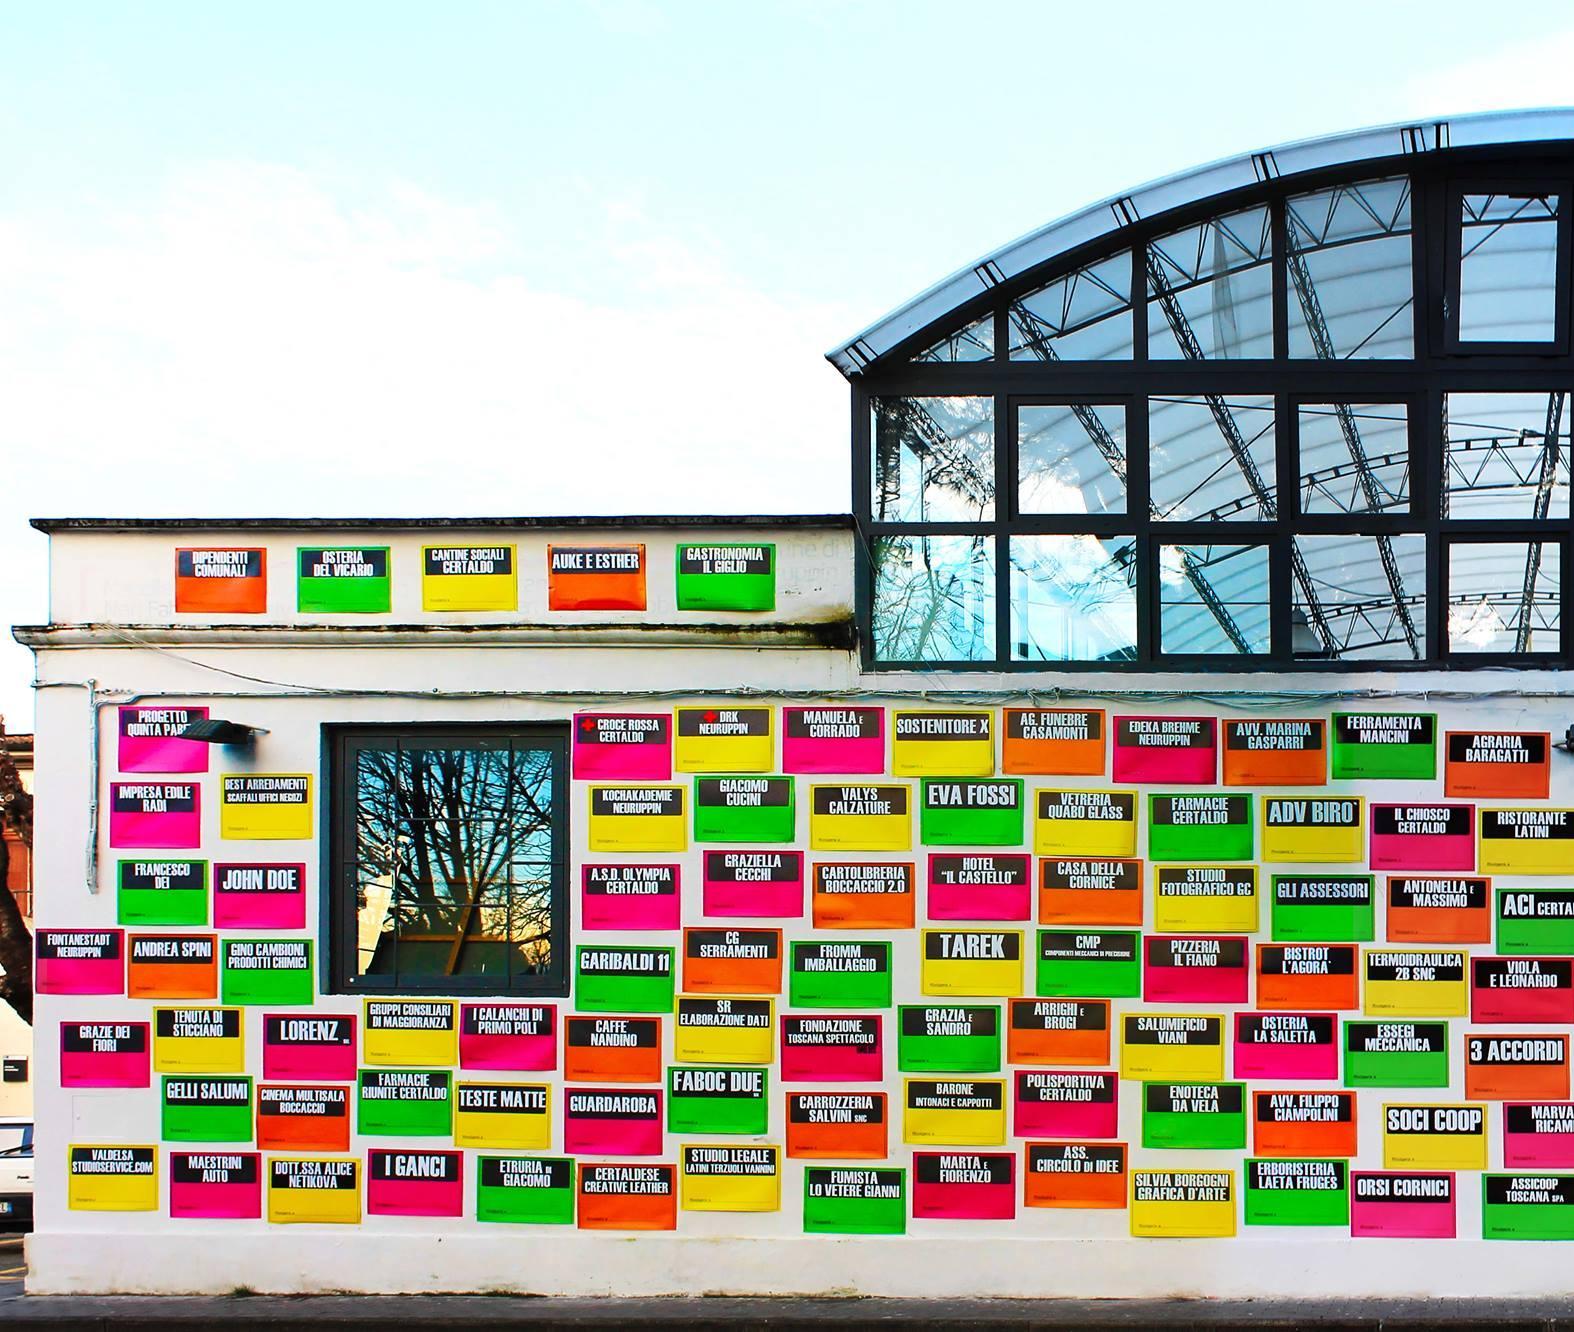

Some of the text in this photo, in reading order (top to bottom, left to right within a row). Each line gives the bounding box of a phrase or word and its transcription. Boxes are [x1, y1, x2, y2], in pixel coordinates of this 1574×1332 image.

[192, 550, 248, 564] DIPENDENTI
[432, 549, 504, 561] CANTINE SOCIALI
[552, 553, 639, 569] AUKE E ESTHER
[687, 548, 763, 561] GASTRONOMIA
[195, 563, 246, 577] COMUNALI
[443, 560, 493, 574] CERTALDO
[703, 560, 747, 573] IL GIGLIO
[138, 710, 187, 723] PROGETTO
[1347, 716, 1422, 730] FERRAMENTA
[128, 723, 162, 737] QUINTA
[897, 719, 988, 734] SOSTENITORE X
[1129, 721, 1200, 733] EDEKA BREHME
[1139, 734, 1190, 746] NEURUPPIN
[1360, 730, 1409, 743] MANCINI
[225, 779, 307, 790] BEST ARREDAMENTI
[227, 793, 257, 802] SCAFFALI
[279, 793, 302, 802] NEGOZI
[602, 790, 672, 801] KOCHAKADEMIE
[613, 803, 661, 814] NEURUPPIN
[1498, 812, 1567, 825] RISTORANTE
[1515, 825, 1549, 838] LATINI
[822, 866, 905, 879] CARTOLIBRERIA
[826, 880, 905, 893] BOCCACCIO 2.0
[1278, 883, 1368, 898] GLI ASSESSORI
[47, 934, 110, 946] FONTANESTADT
[940, 934, 1005, 958] TAREK
[1076, 936, 1100, 949] CMP
[57, 947, 101, 957] NEURUPPIN
[231, 943, 304, 956] GINO CAMBIONI
[228, 956, 306, 968] PRODOTTI CHIMICI
[581, 952, 669, 971] GARIBALDI 11
[1507, 961, 1540, 974] VIOLA
[1490, 974, 1557, 987] E LEONARDO
[370, 1004, 451, 1016] GRUPPI CONSILIARI
[373, 1016, 447, 1028] DI MAGGIORANZA
[800, 1020, 862, 1032] FONDAZIONE
[1377, 1025, 1414, 1038] ESSEGI
[788, 1034, 874, 1043] TOSCANA SPETTACOLO
[1365, 1037, 1430, 1051] MECCANICA
[261, 1089, 345, 1102] CINEMA MULTISALA
[936, 1083, 973, 1095] BARONE
[1170, 1086, 1218, 1099] ENOTECA
[280, 1102, 325, 1114] BOCCACCIO
[570, 1096, 656, 1113] GUARDAROBA
[916, 1097, 992, 1107] INTONACI E CAPPOTTI
[1173, 1099, 1219, 1112] DA VELA
[92, 1150, 133, 1161] VALDELSA
[692, 1149, 769, 1163] STUDIO LEGALE
[1064, 1146, 1089, 1159] ASS.
[72, 1161, 153, 1173] STUDIOSERVICE.COM
[385, 1155, 445, 1177] I GANCI
[686, 1164, 775, 1173] LATINI TERZUOLI VANNINI
[1037, 1159, 1119, 1173] CIRCOLO DI IDEE
[1258, 1162, 1335, 1176] ERBORISTERIA
[831, 1171, 878, 1184] FUMISTA
[1259, 1176, 1337, 1189] LAETA FRUGES
[1511, 1178, 1558, 1190] ASSICOOP
[810, 1184, 899, 1197] LO VETERE GIANNI
[1506, 1191, 1550, 1202] TOSCANA
